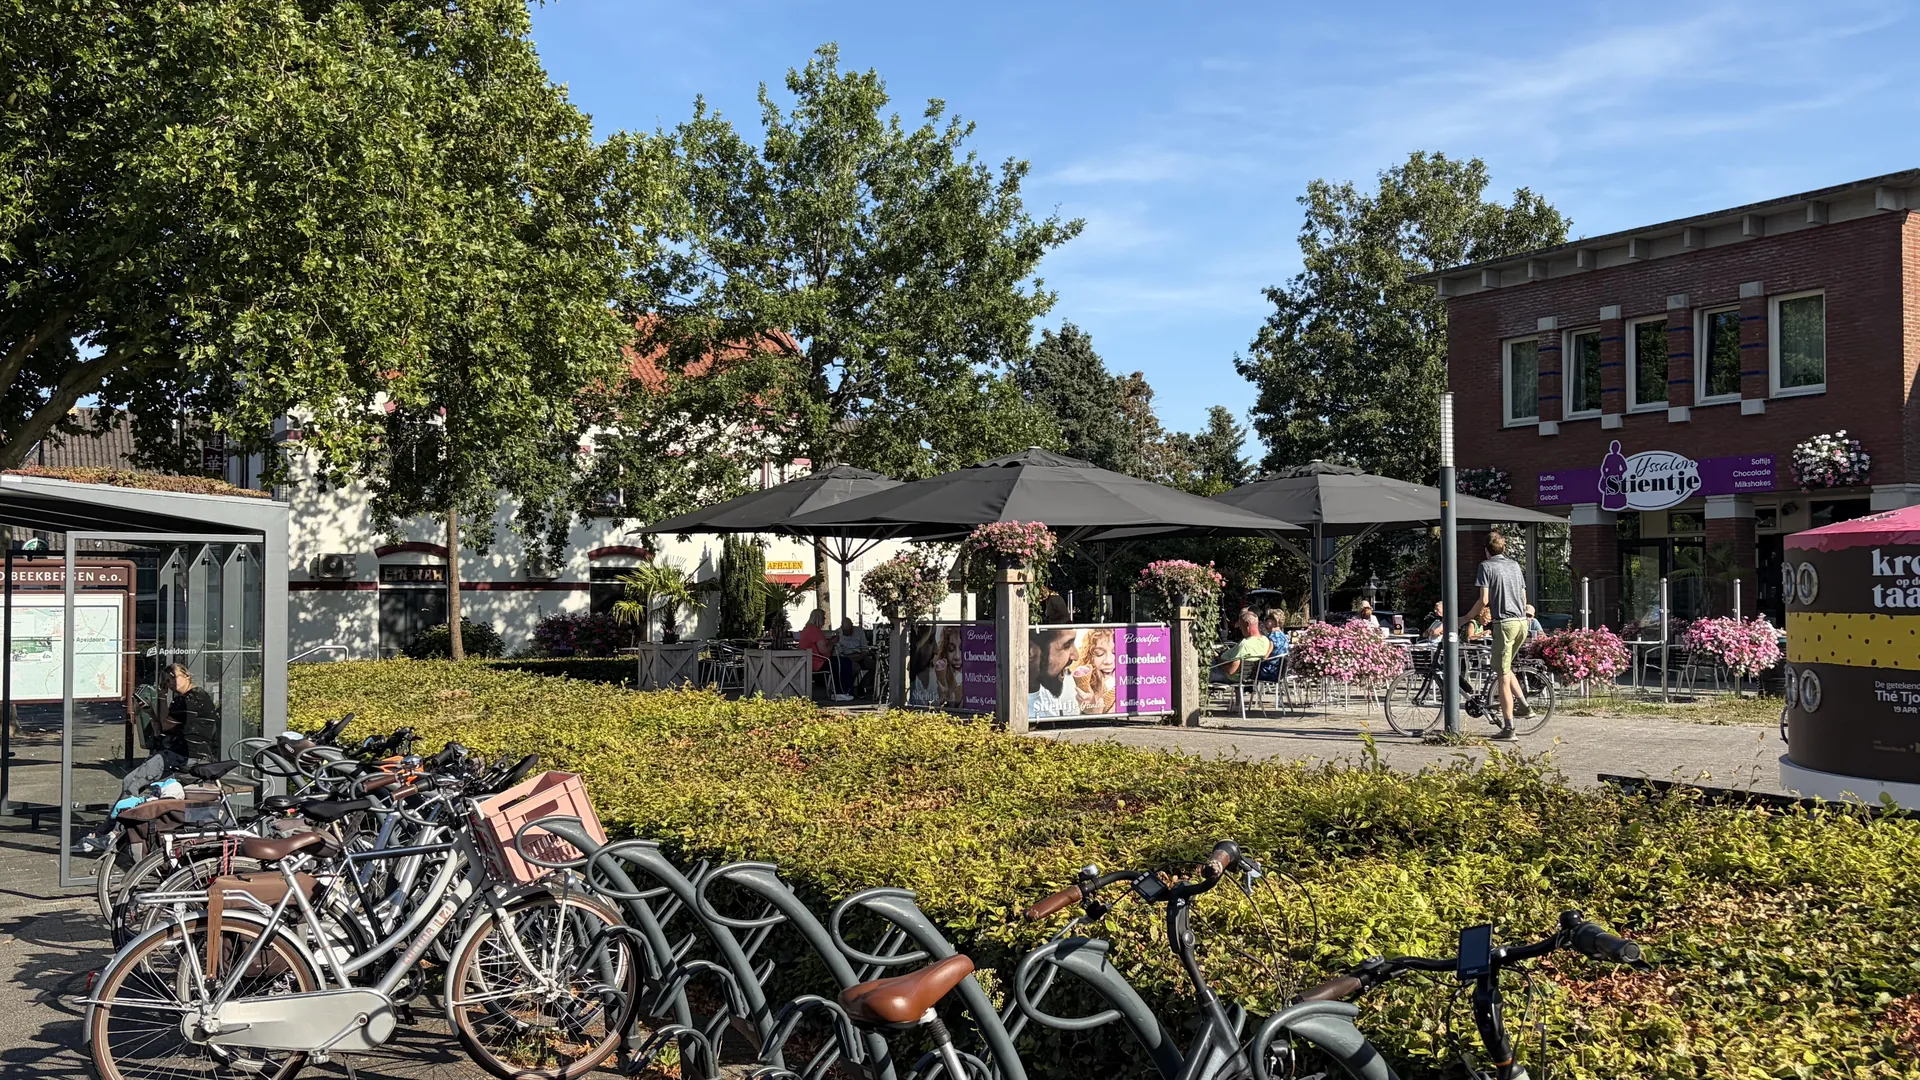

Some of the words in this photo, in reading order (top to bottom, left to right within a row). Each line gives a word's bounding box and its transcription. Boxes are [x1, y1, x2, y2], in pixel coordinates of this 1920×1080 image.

[1751, 457, 1771, 466] Softijs
[1539, 474, 1555, 482] Koffie
[1732, 468, 1771, 478] Chocolade
[1539, 484, 1564, 492] Broodjes
[1606, 470, 1700, 496] Stientje
[1734, 480, 1771, 488] Milkshakes
[767, 561, 803, 570] AFHALEN
[11, 571, 94, 581] BEEKBEREN
[99, 573, 122, 581] e.o.
[1896, 578, 1910, 588] op
[967, 629, 993, 644] Broodjes
[1123, 632, 1161, 647] Broodjes
[159, 648, 197, 656] Apeldoorn
[1118, 653, 1167, 665] Chocolade
[1119, 675, 1167, 686] Milkshakes
[1874, 680, 1886, 689] De
[1874, 690, 1898, 702] Thé
[1120, 699, 1139, 707] Koffie
[1146, 697, 1167, 705] Gebak
